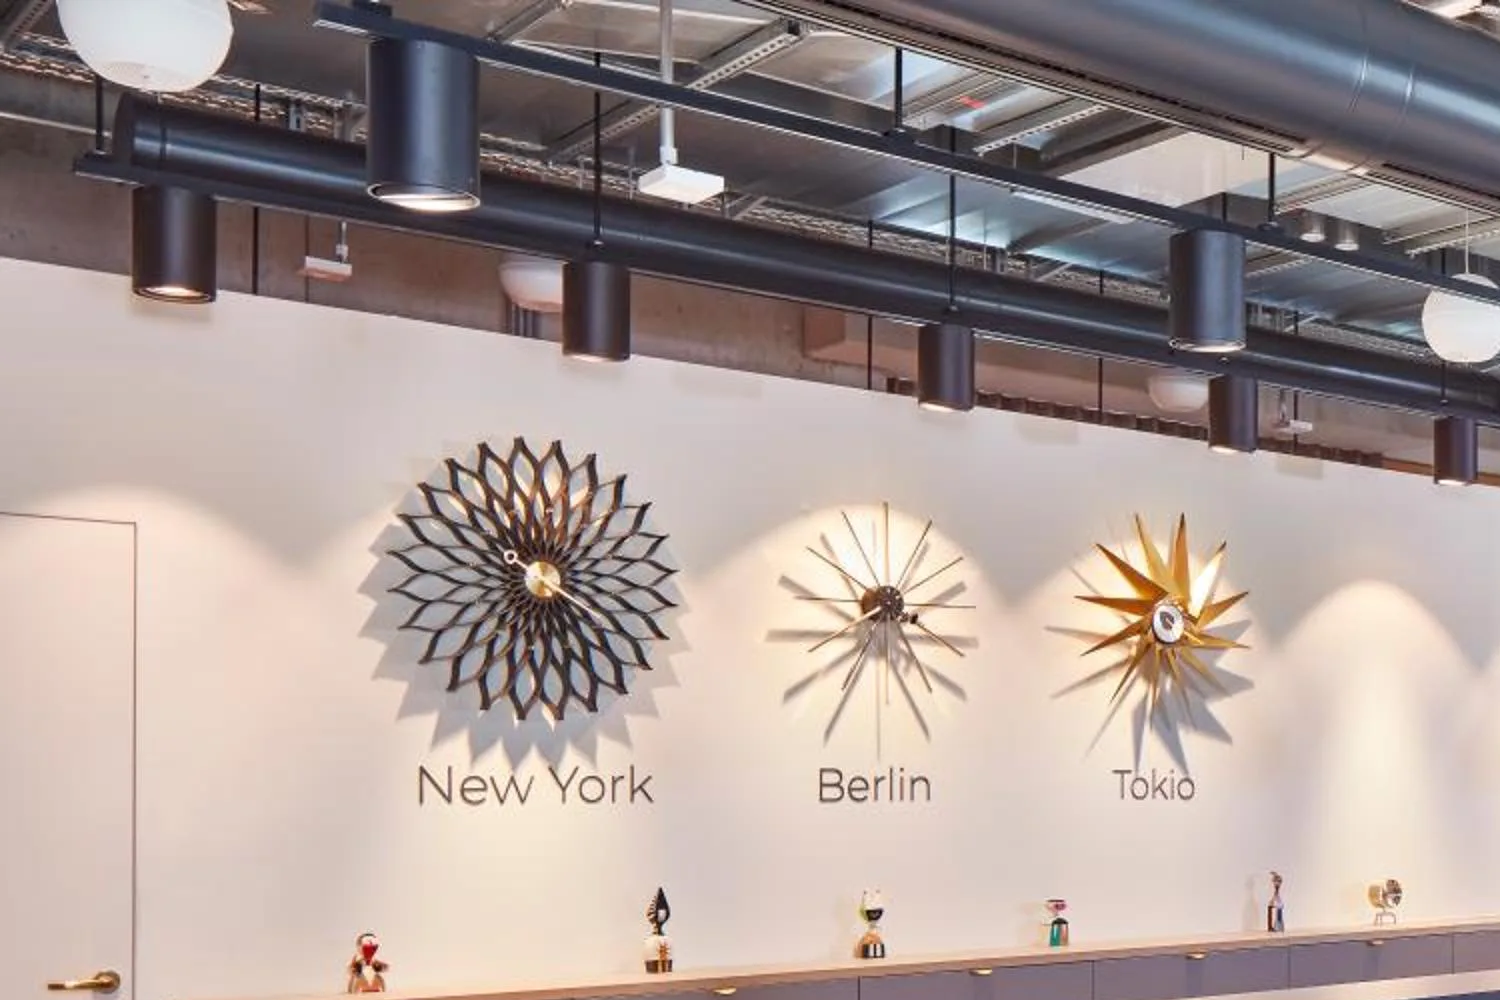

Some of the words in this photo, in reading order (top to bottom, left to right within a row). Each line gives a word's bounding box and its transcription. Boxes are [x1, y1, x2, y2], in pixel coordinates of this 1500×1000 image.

[418, 765, 535, 806] New
[547, 764, 654, 805] York
[818, 766, 931, 803] Berlin
[1112, 767, 1195, 801] Tokio
